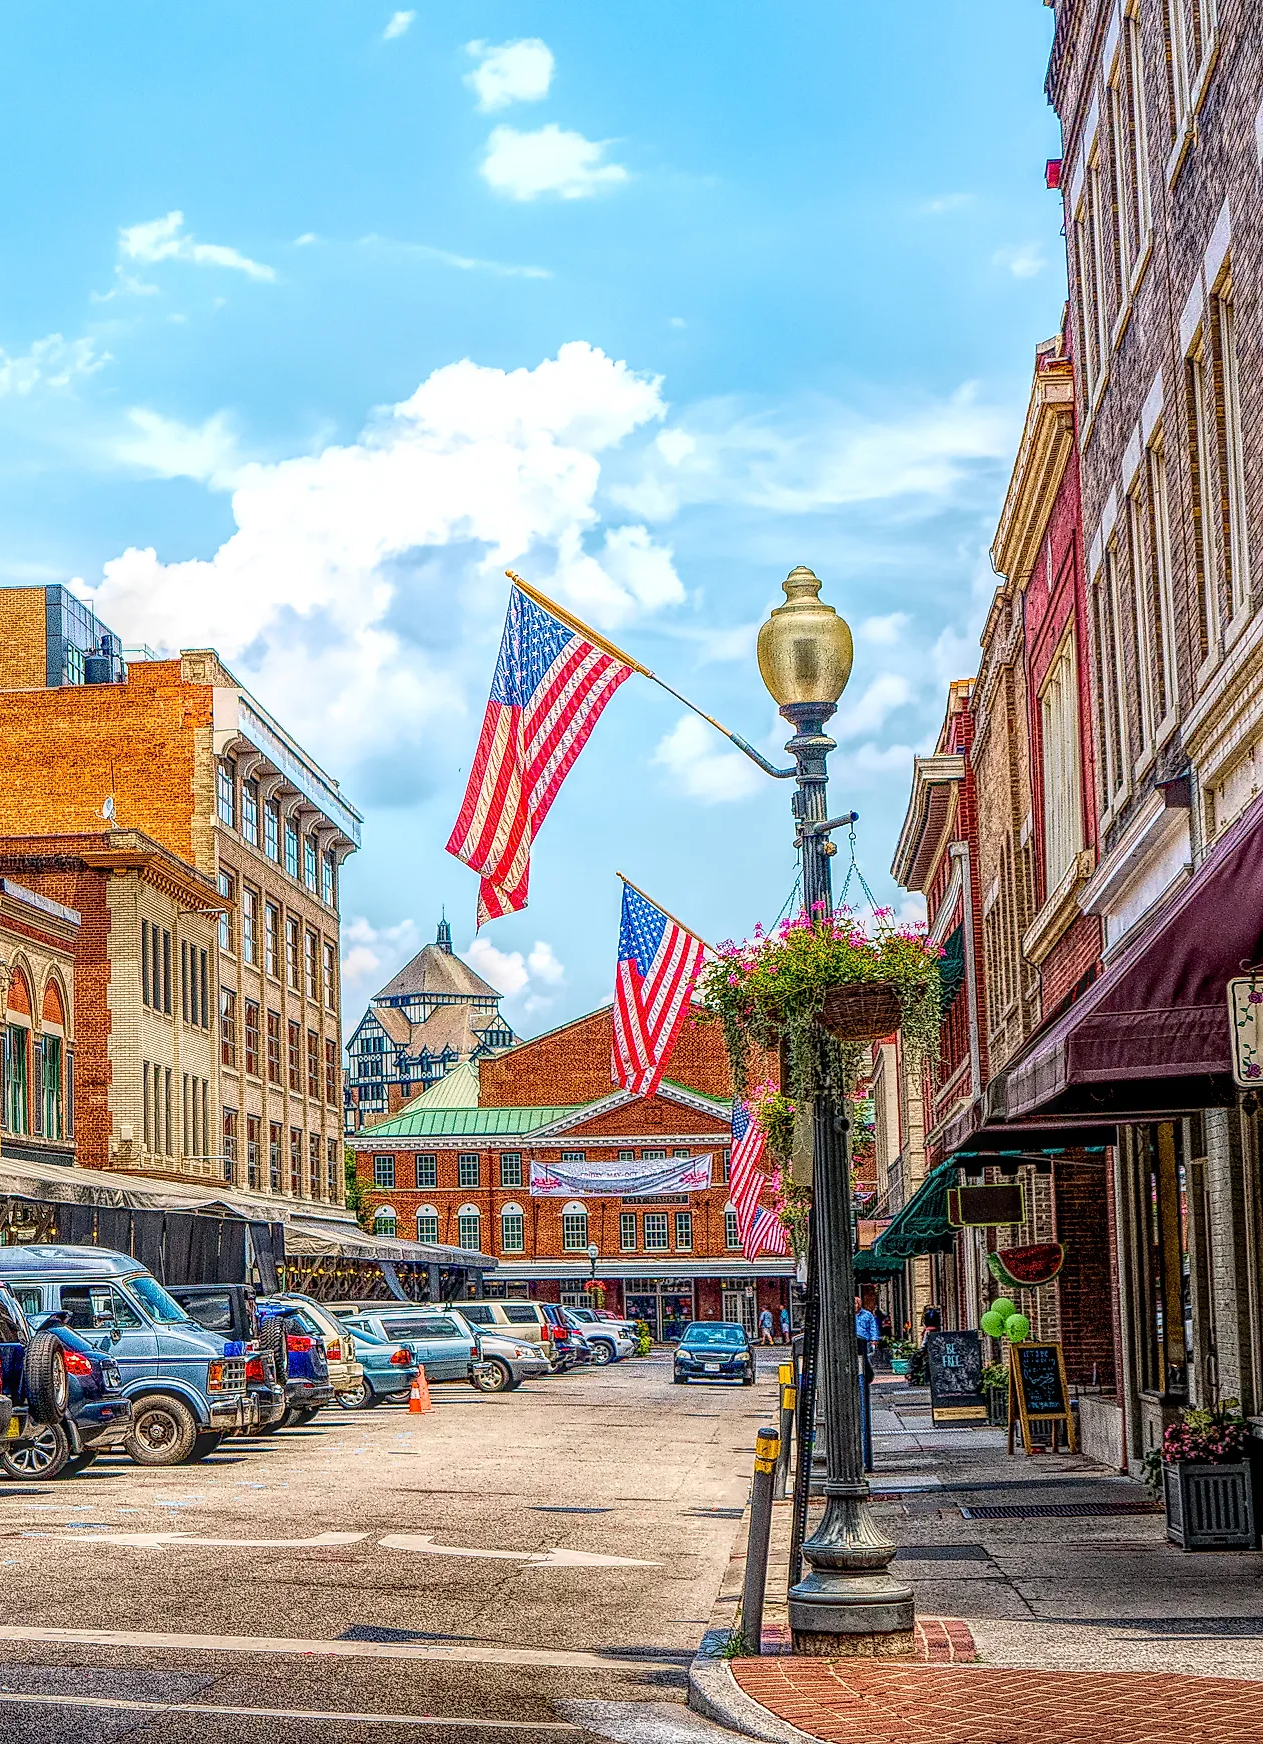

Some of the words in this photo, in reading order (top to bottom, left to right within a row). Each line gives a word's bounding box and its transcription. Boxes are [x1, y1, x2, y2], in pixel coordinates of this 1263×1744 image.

[626, 1196, 645, 1204] CITY
[648, 1195, 685, 1204] MARKET
[946, 1343, 957, 1354] BE
[942, 1355, 964, 1367] FREE
